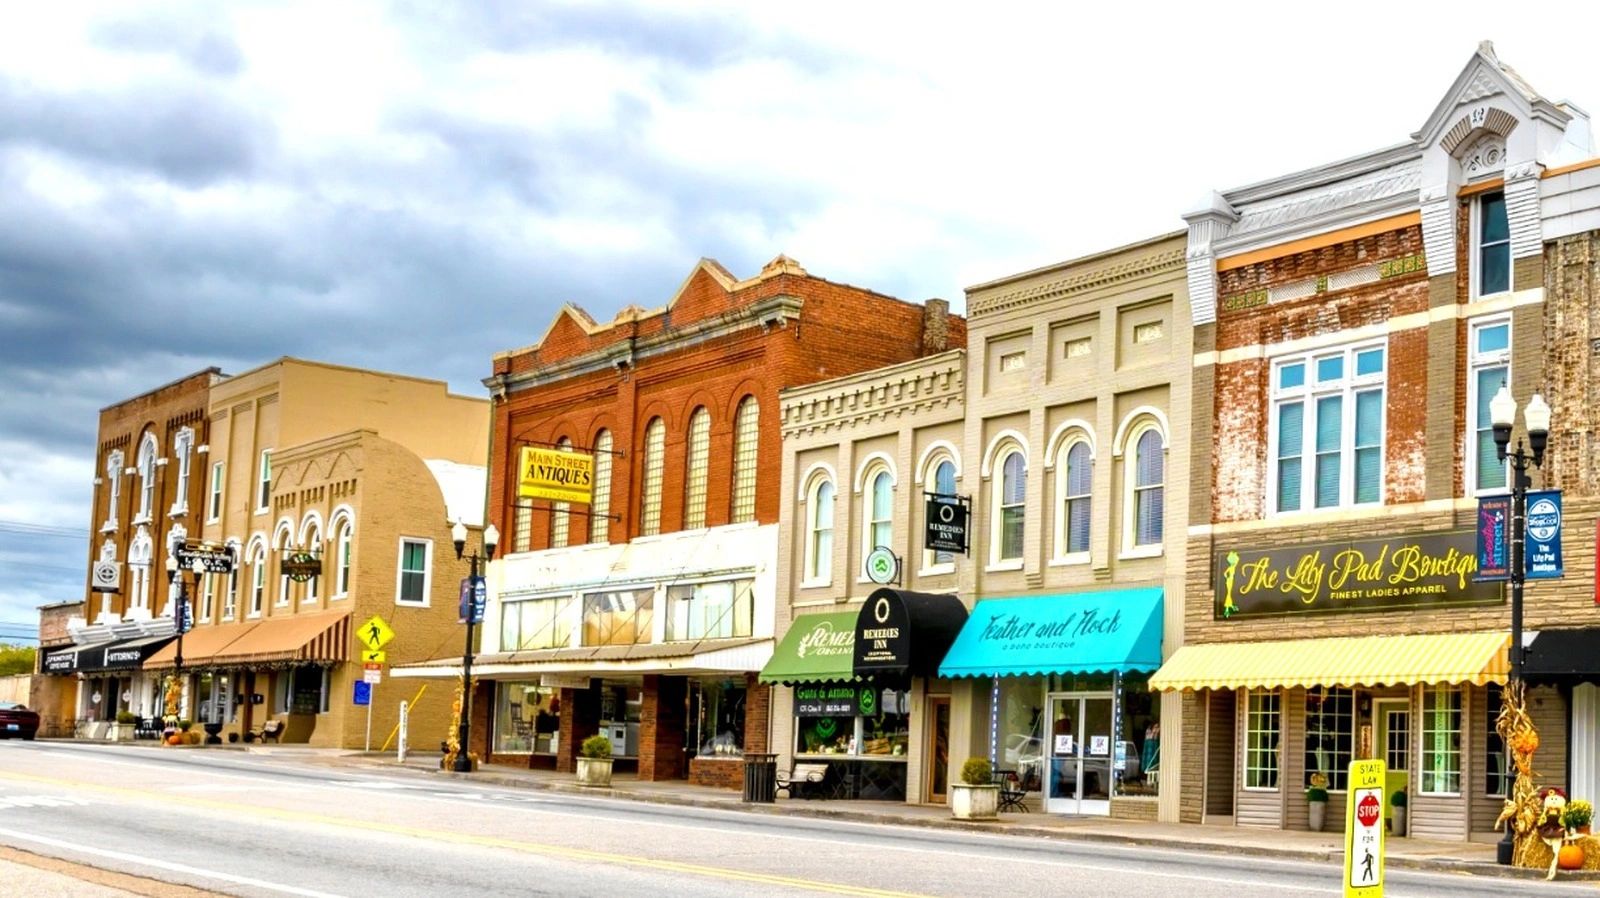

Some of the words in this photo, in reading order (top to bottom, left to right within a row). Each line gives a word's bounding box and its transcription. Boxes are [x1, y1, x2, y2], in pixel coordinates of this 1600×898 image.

[527, 451, 552, 465] MAIN
[554, 454, 590, 470] STREET
[526, 464, 591, 486] ANTIQUES
[1494, 523, 1503, 566] street
[1240, 557, 1278, 594] The
[1281, 550, 1326, 604] Lily
[1329, 545, 1389, 590] Pad
[1330, 590, 1363, 600] FINEST
[1366, 588, 1400, 598] LADIES
[1403, 584, 1447, 595] APPAREL
[979, 614, 1036, 641] Feather
[1035, 612, 1077, 638] and
[1072, 607, 1121, 638] Flock
[863, 627, 900, 639] REMEDIES
[873, 639, 888, 649] INN
[1360, 764, 1380, 774] STATE
[1363, 777, 1377, 785] LAW
[1359, 805, 1380, 818] STOP
